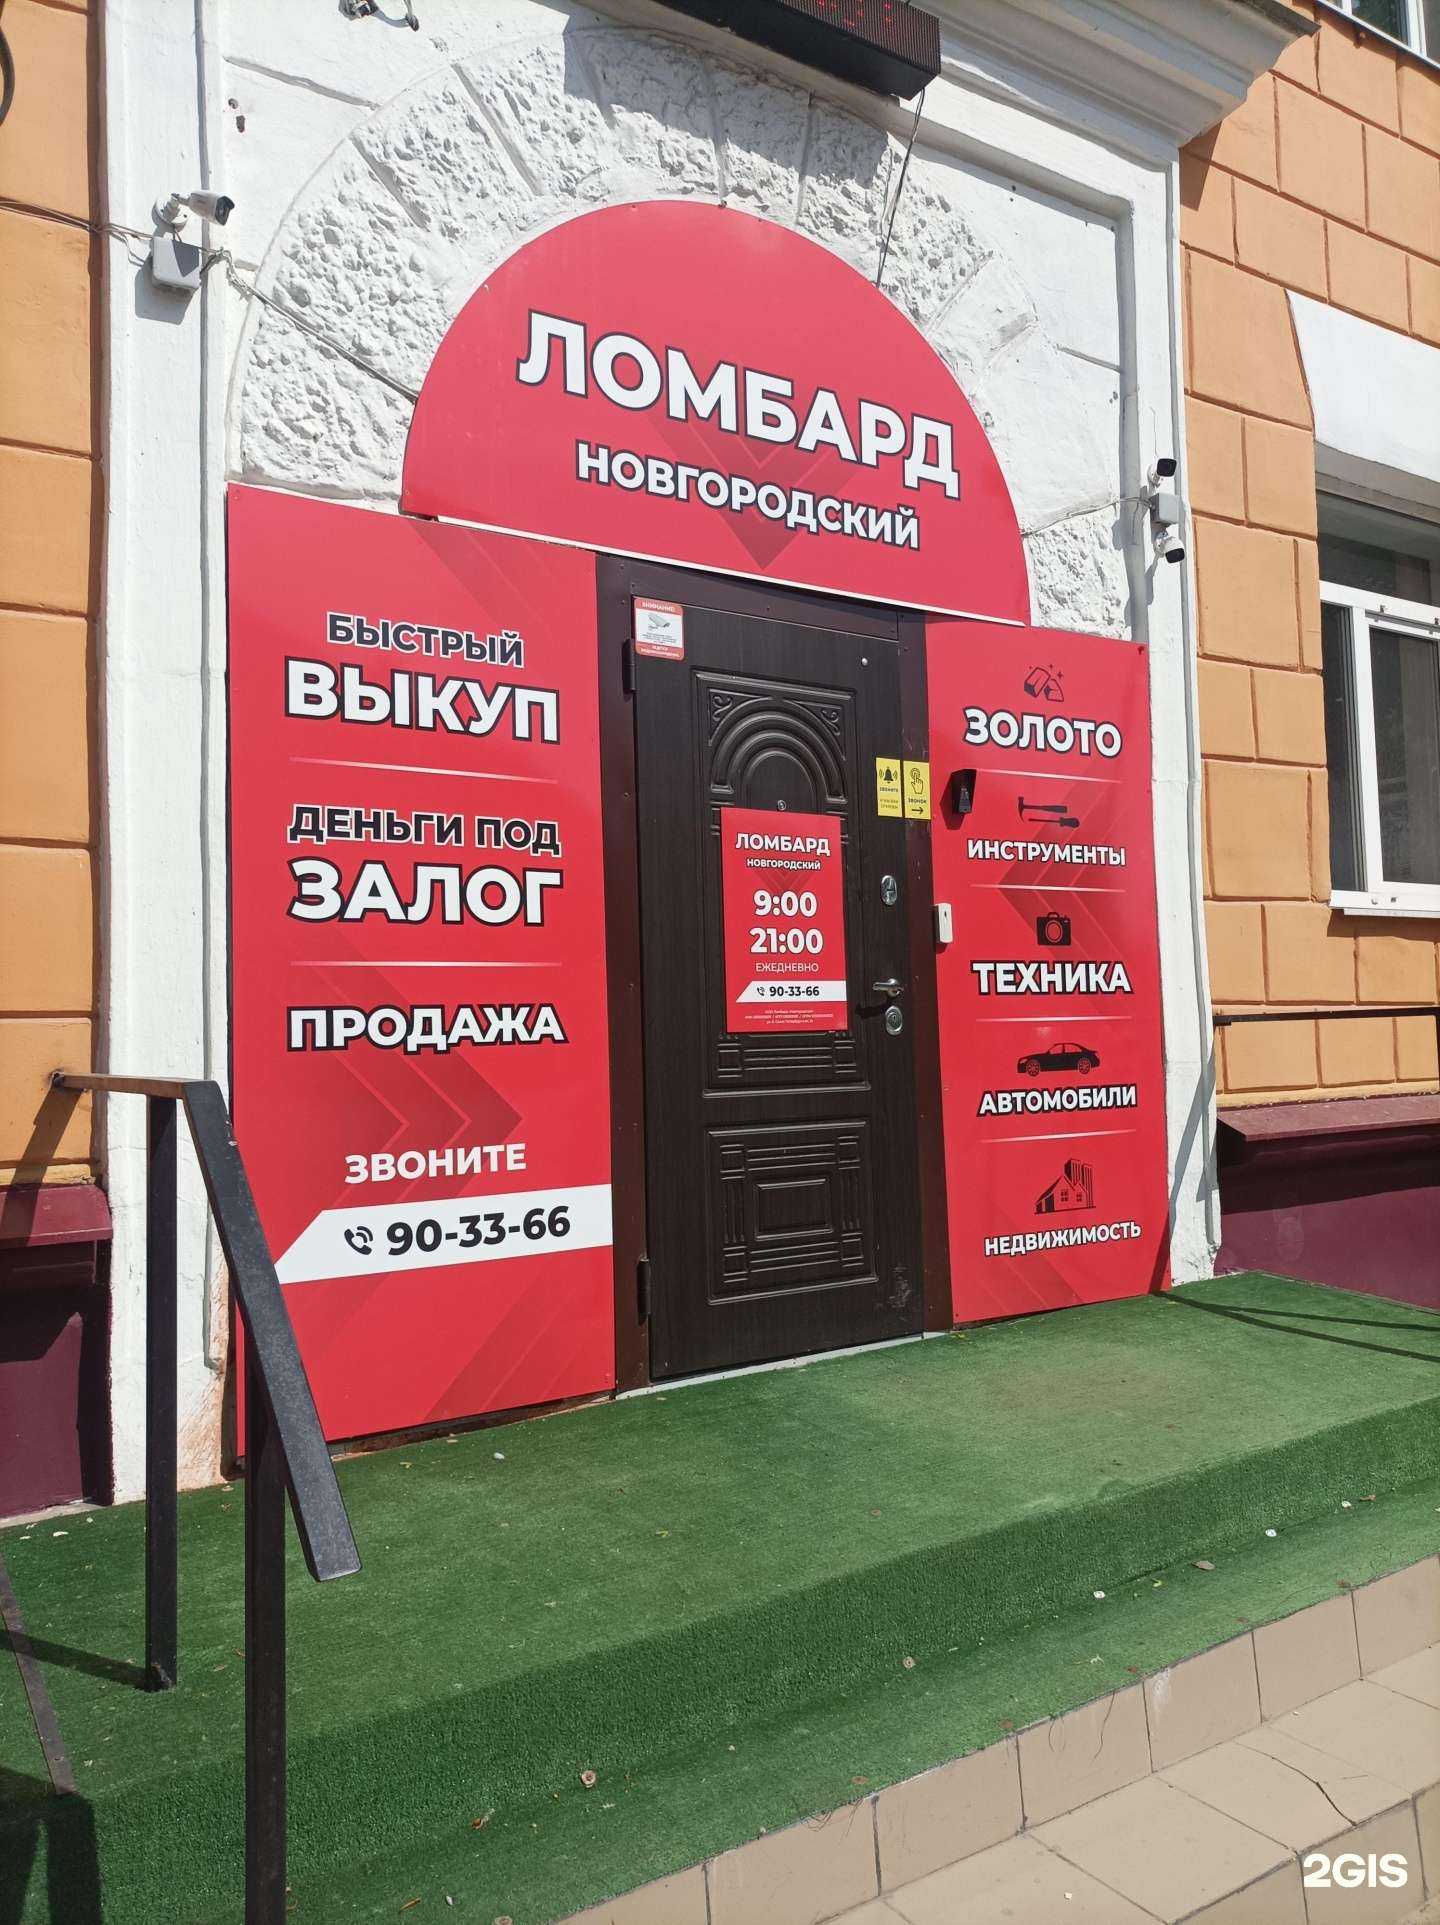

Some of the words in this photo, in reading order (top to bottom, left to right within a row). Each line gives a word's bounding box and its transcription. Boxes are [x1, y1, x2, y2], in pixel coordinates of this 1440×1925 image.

[516, 309, 961, 499] ЛОМБАРД
[575, 440, 922, 551] НОВГОРОДСКИЙ
[327, 611, 524, 668] БЫСТРЫЙ
[285, 656, 560, 745] ВЫКУП
[963, 706, 1123, 757] ЗОЛОТО
[287, 804, 464, 847] ДЕНЬГИ
[475, 815, 562, 857] ПОД
[735, 833, 831, 857] ЛОМБАРД
[746, 858, 821, 871] НОВГОРОДСКИЙ
[966, 838, 1127, 867] ИНСТРУМЕНТЫ
[286, 856, 564, 927] ЗАЛОГ
[753, 889, 818, 918] 9:00
[749, 927, 824, 955] 21:00
[755, 962, 820, 974] ЕЖЕДНЕВНО
[970, 960, 1134, 997] ТЕХНИКА
[769, 986, 820, 997] 90-33-66
[286, 1002, 569, 1056] ПРОДАЖА
[976, 1083, 1138, 1118] АВТОМОБИЛИ
[344, 1143, 527, 1184] ЗВОНИТЕ
[386, 1205, 571, 1256] 90-33-66
[984, 1221, 1142, 1257] НЕДВИЖИМОСТЬ
